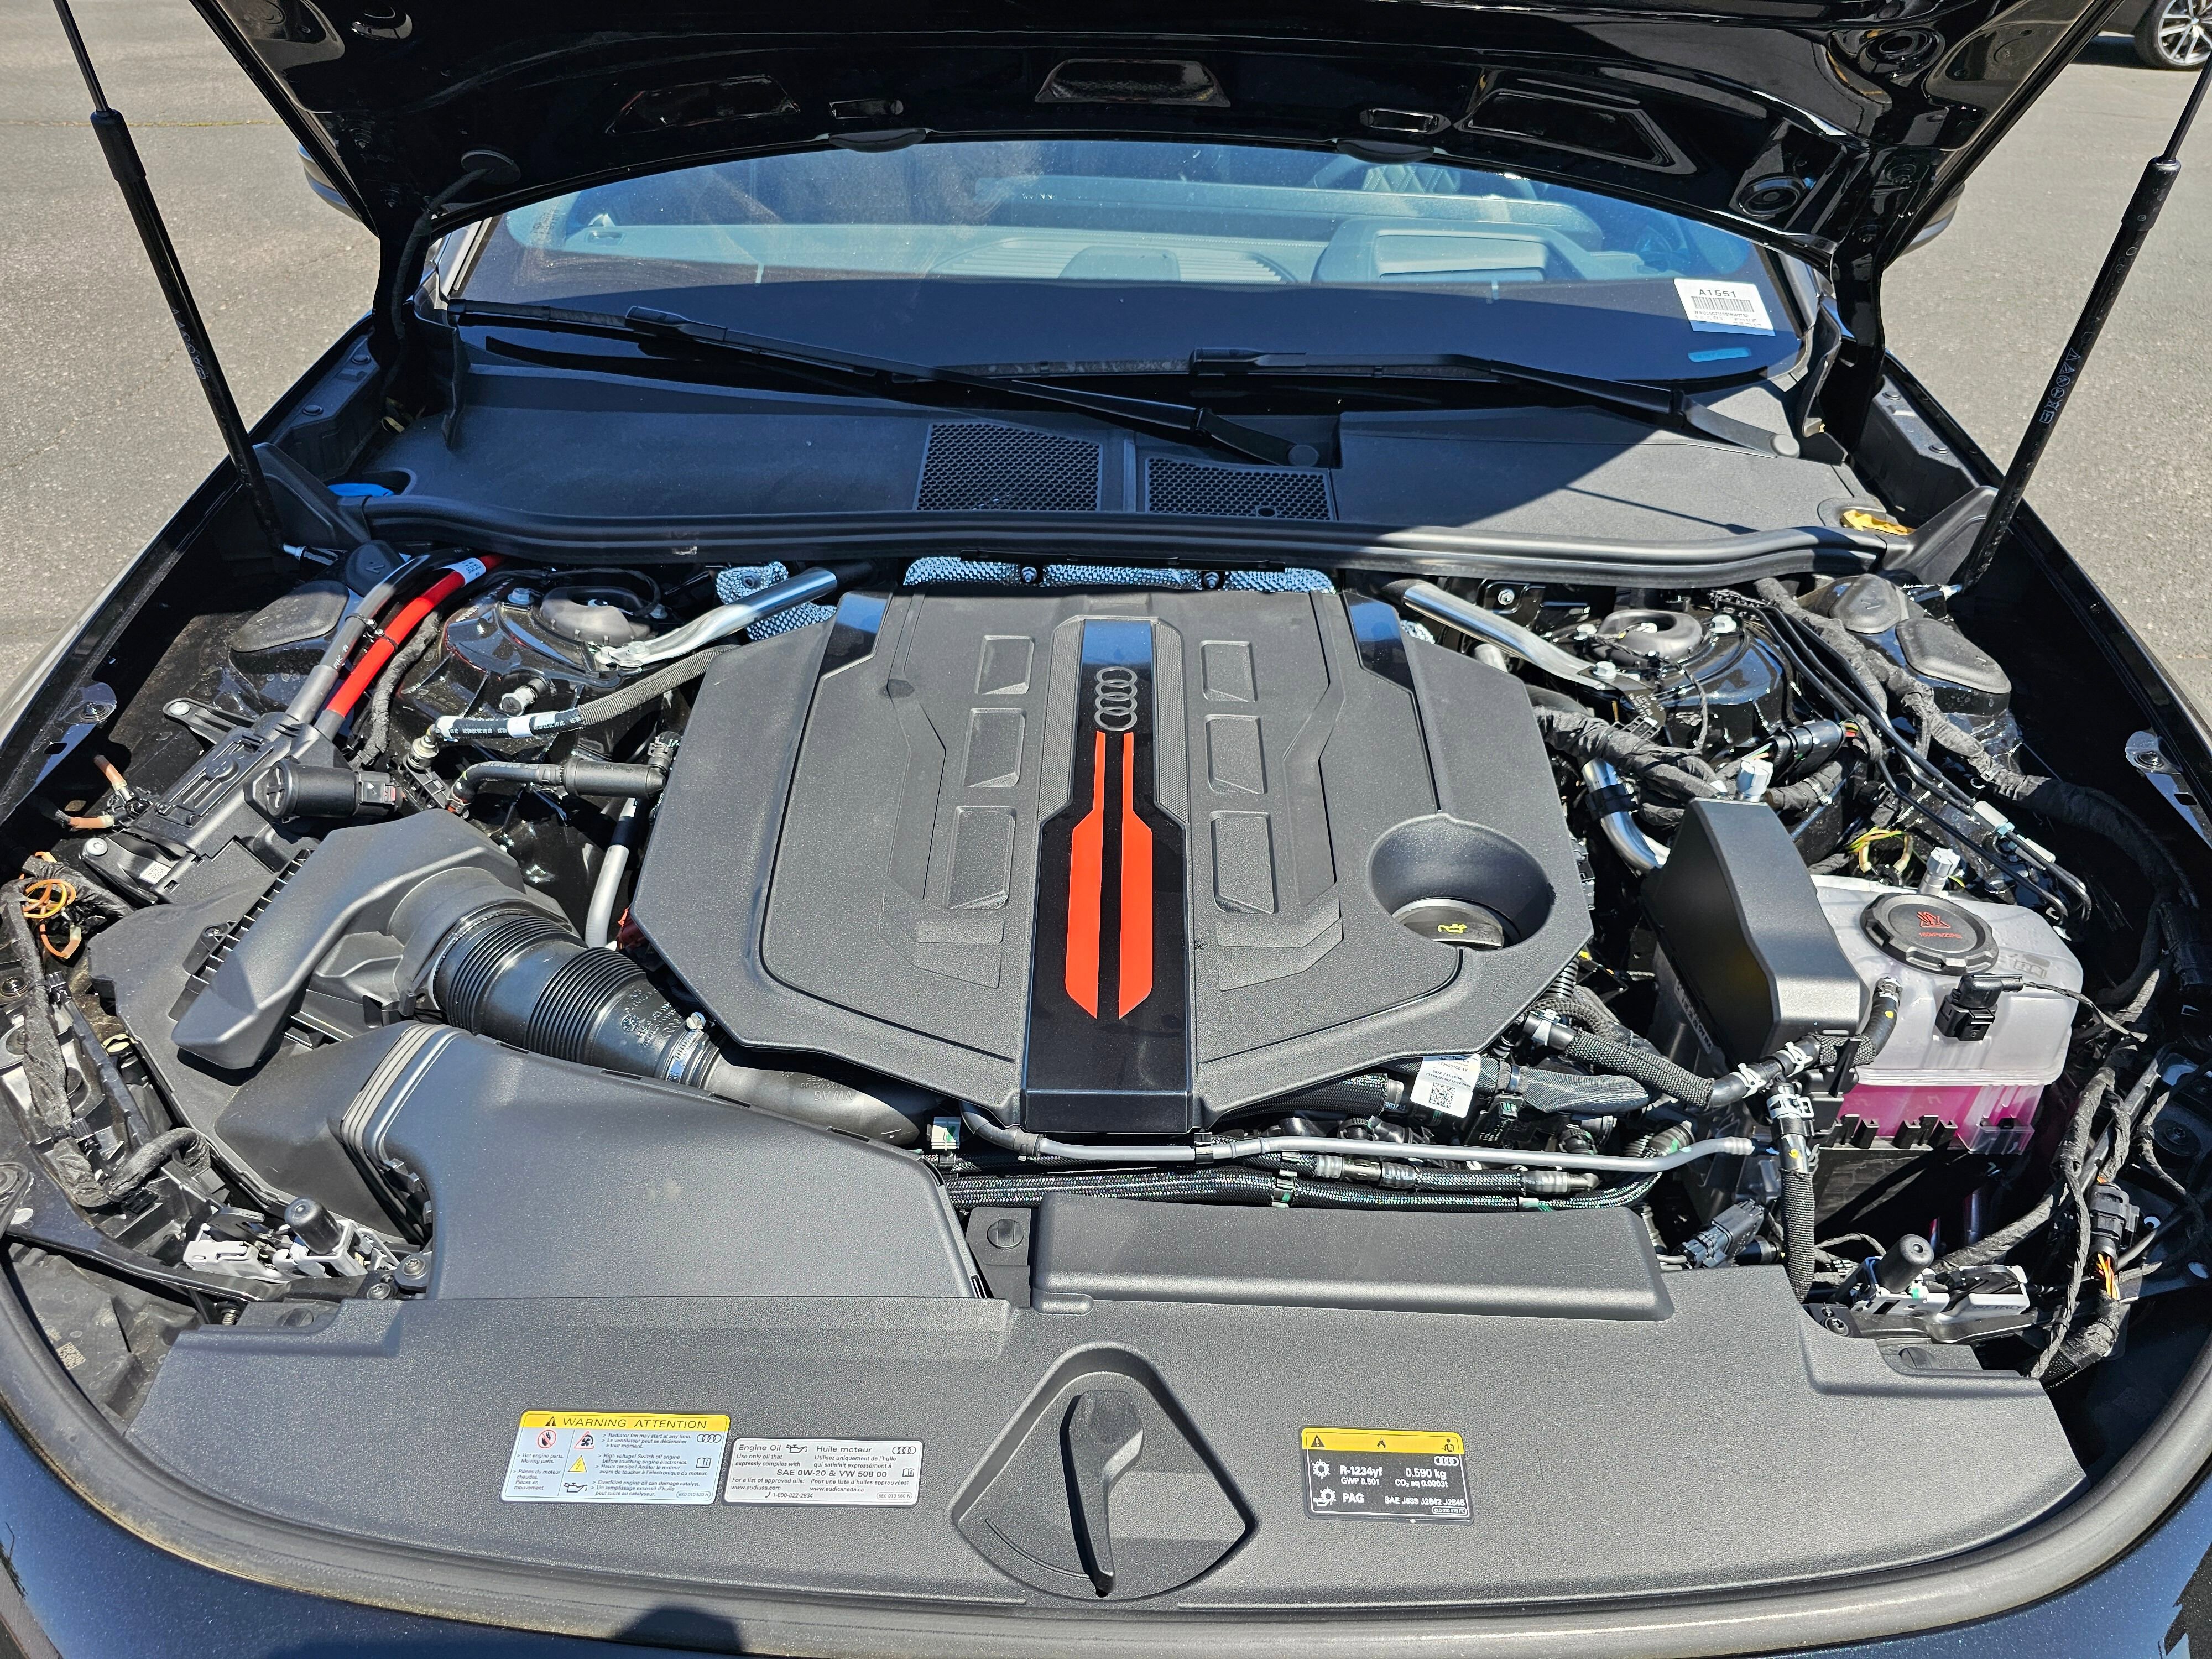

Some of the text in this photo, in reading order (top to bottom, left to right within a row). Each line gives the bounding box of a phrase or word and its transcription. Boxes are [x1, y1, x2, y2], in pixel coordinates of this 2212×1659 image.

[813, 1090, 852, 1100] VW AG
[564, 1418, 707, 1428] WARNING ATTENTION
[1340, 1465, 1383, 1477] R-1234yf
[1405, 1468, 1447, 1480] 0.590 kg
[1342, 1493, 1364, 1503] PAG
